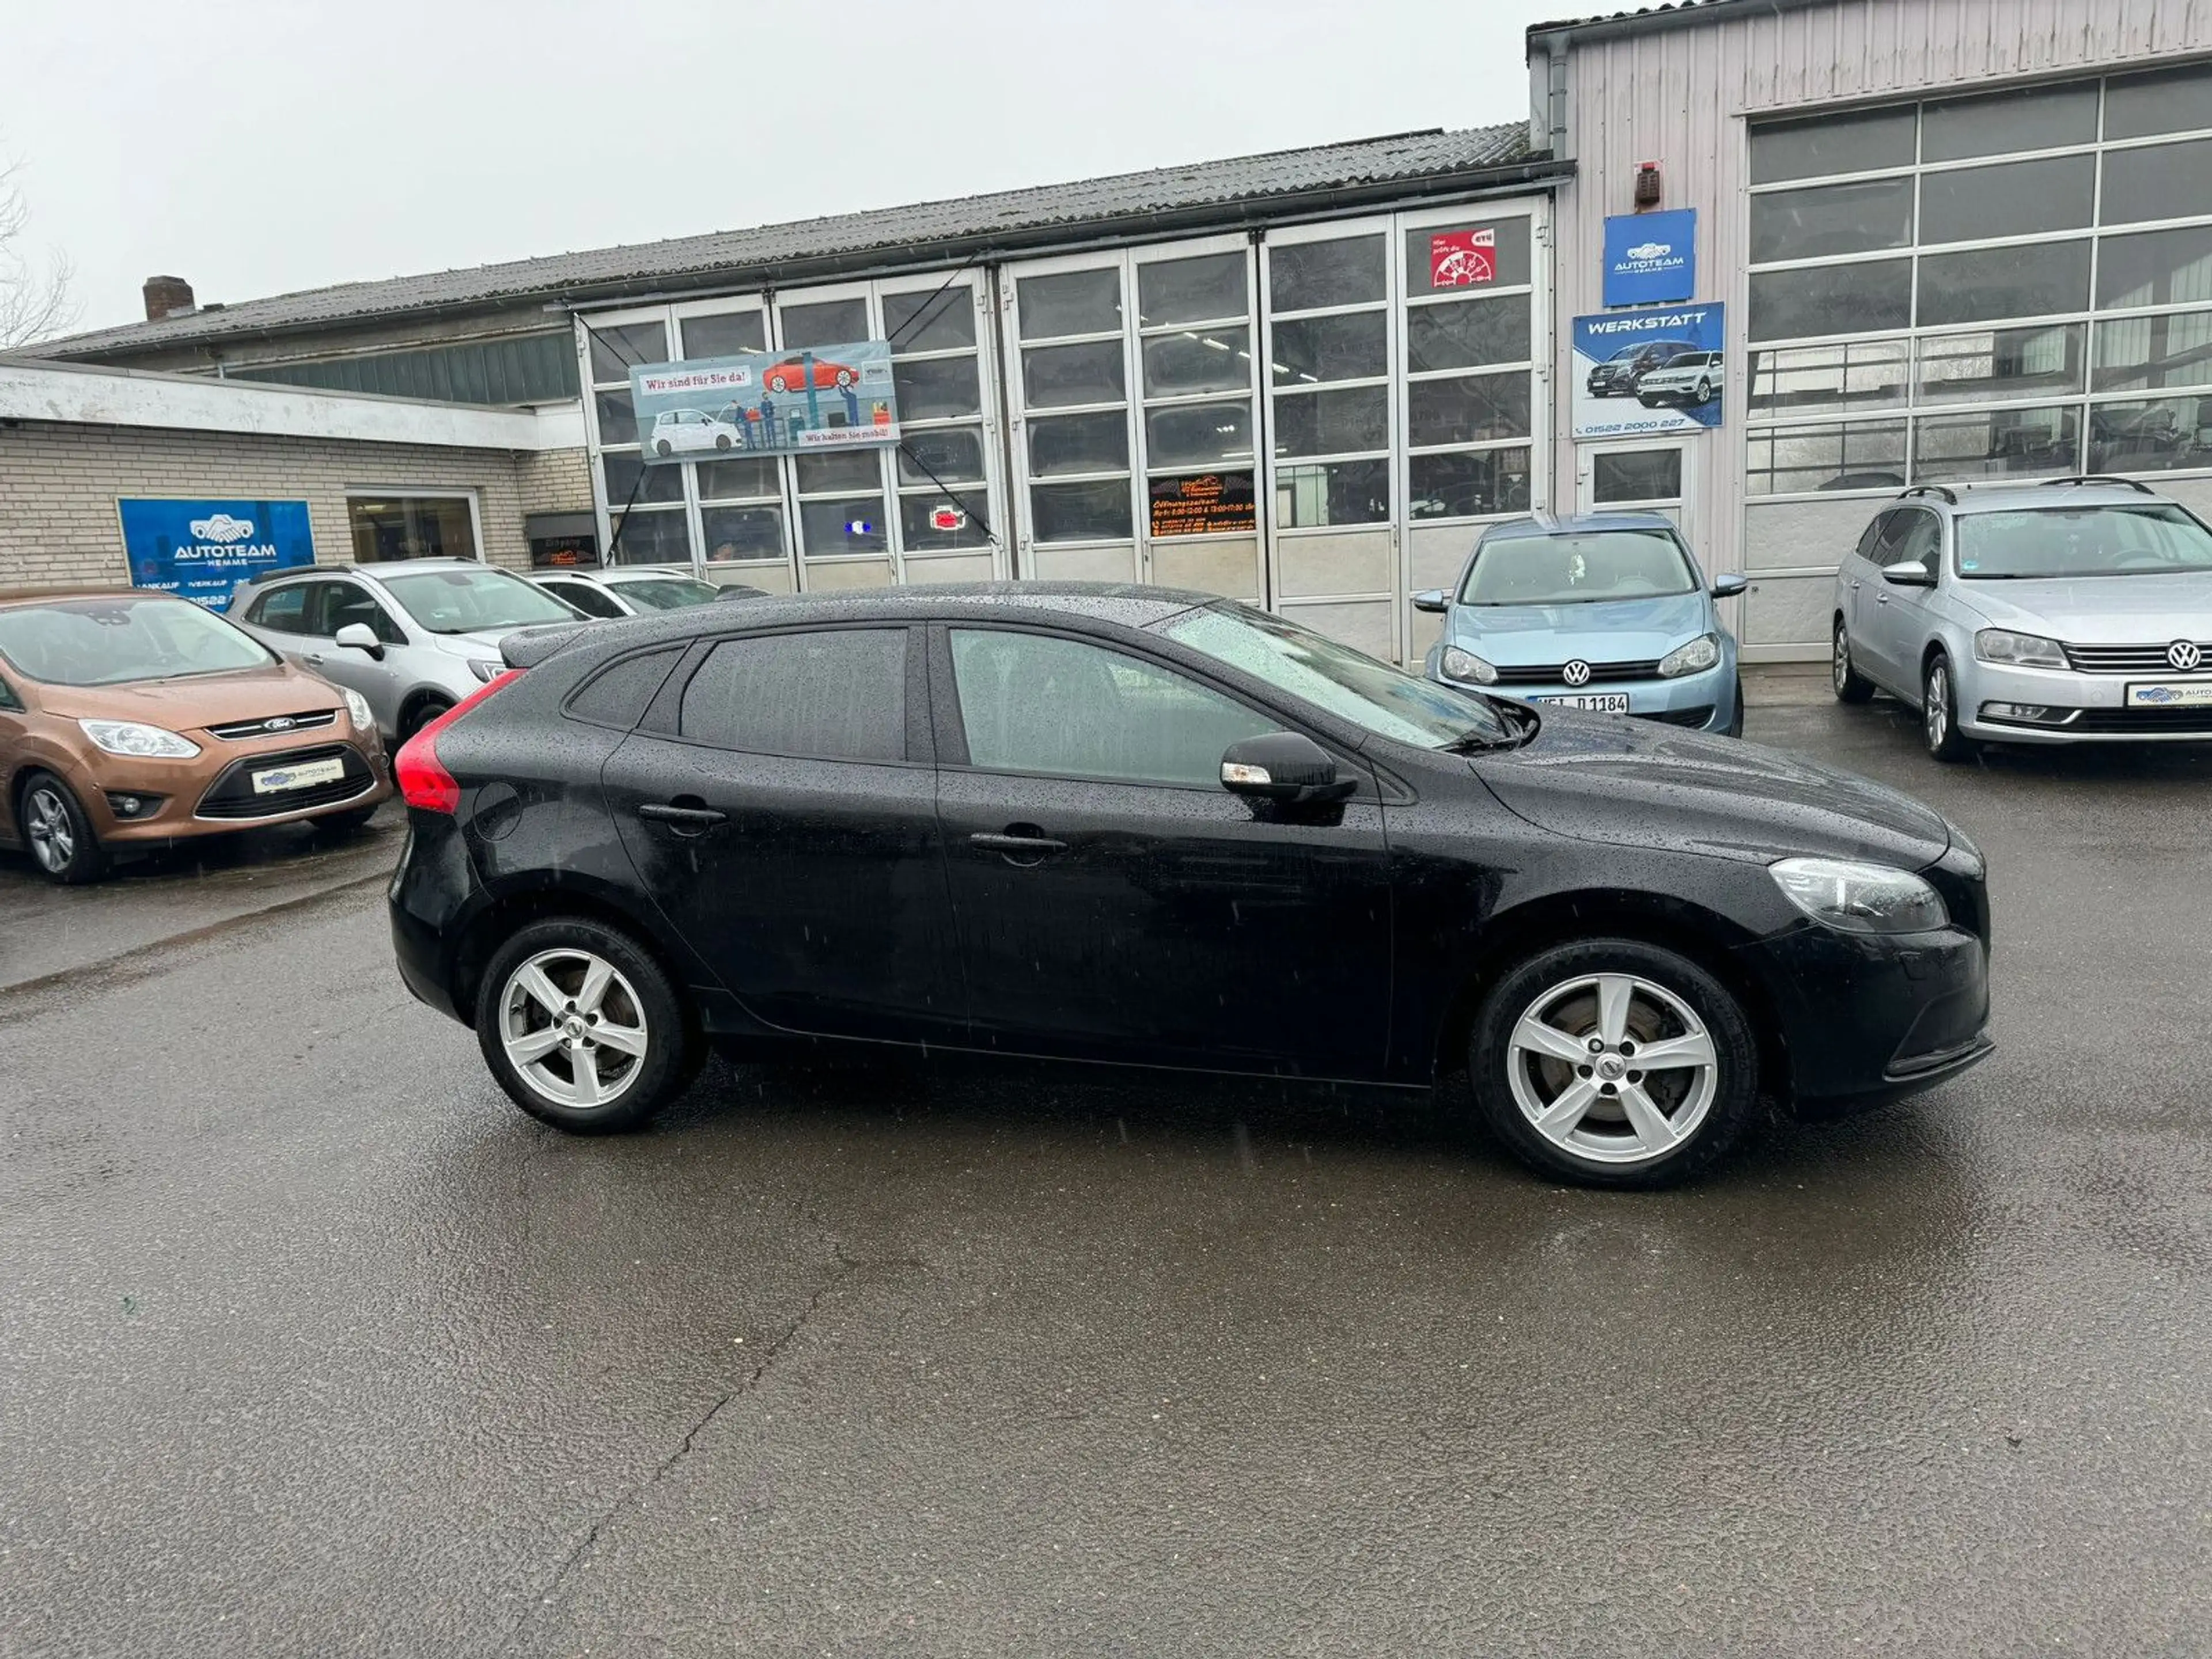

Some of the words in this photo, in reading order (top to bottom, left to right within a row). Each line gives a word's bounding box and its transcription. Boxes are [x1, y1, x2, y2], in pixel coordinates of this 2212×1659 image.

[1615, 257, 1684, 271] AUTOTEAM
[1588, 312, 1707, 335] WERKSTATT
[646, 379, 666, 390] Wir
[668, 376, 691, 388] sind
[692, 374, 709, 385] für
[710, 373, 726, 384] Sie
[729, 372, 745, 382] da!
[1585, 424, 1622, 433] 01522
[1624, 421, 1657, 431] 2000
[1660, 419, 1685, 427] 227
[849, 431, 861, 440] Sie
[175, 544, 276, 559] AUTOTEAM
[207, 559, 248, 567] HEMME
[1590, 696, 1625, 712] 1184
